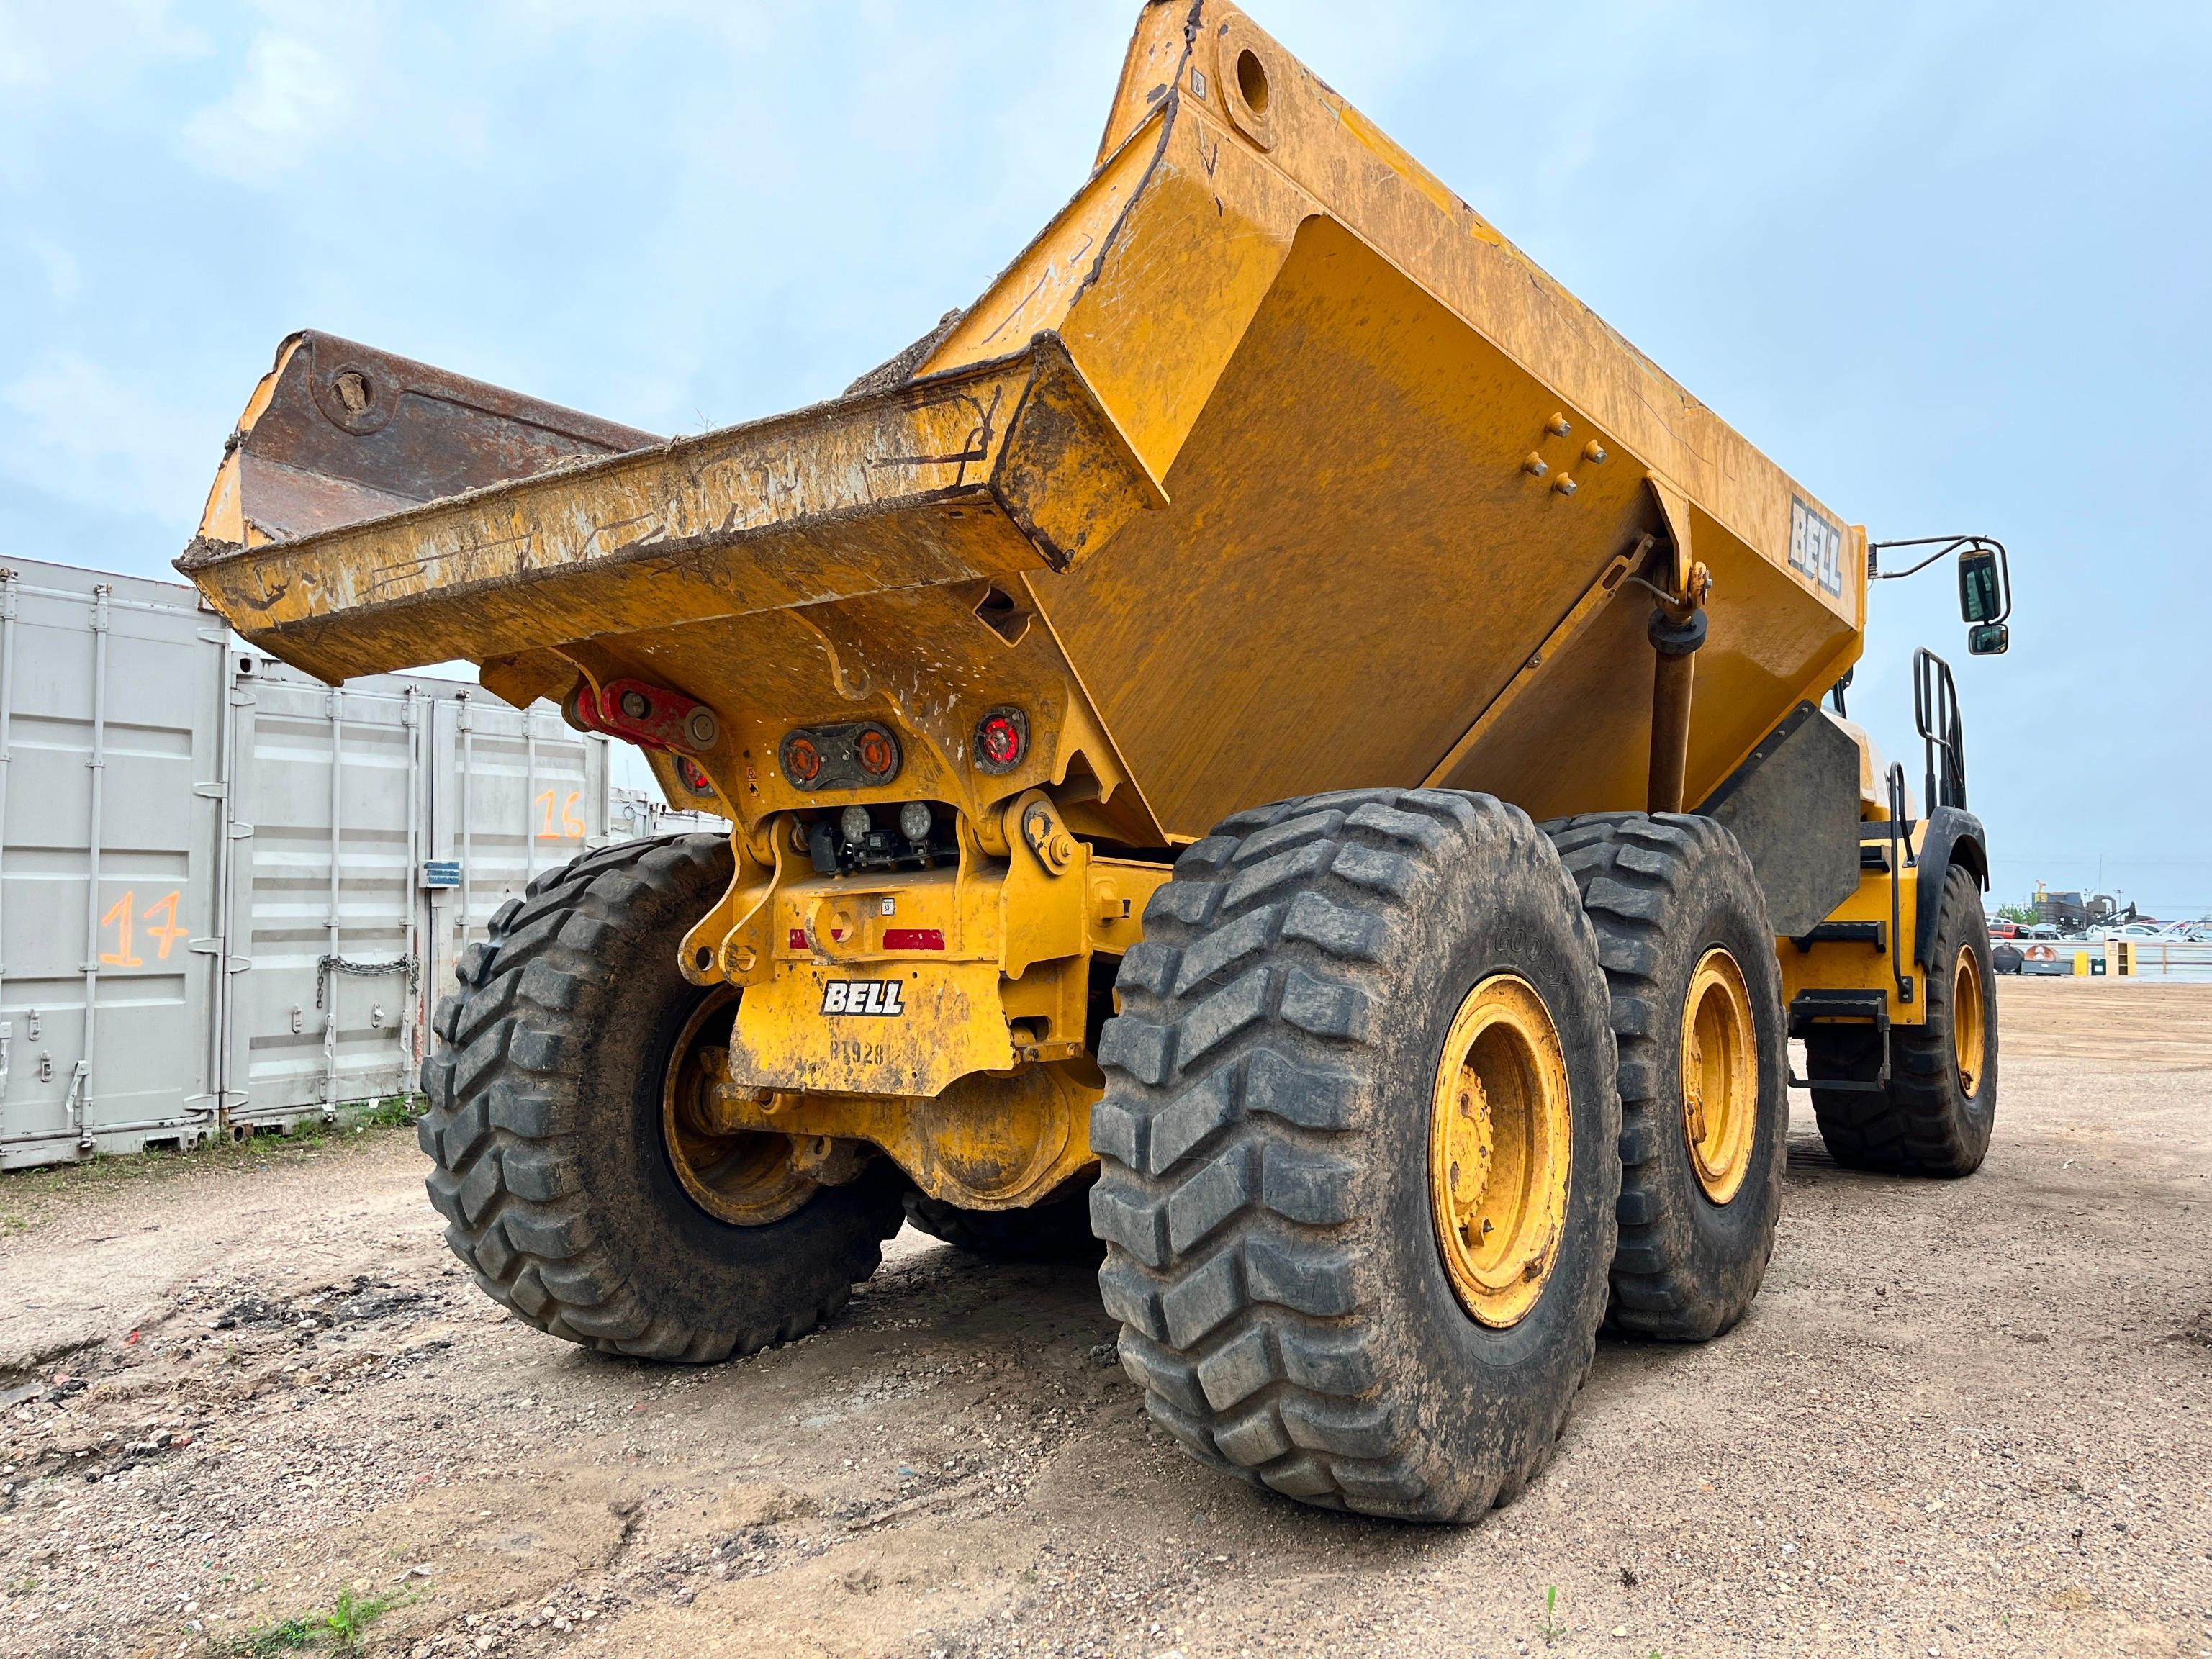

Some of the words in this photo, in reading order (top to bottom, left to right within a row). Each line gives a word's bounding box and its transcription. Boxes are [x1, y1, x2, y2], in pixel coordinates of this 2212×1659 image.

[1789, 495, 1841, 597] BELL
[535, 790, 585, 840] 16
[101, 891, 188, 966] 17
[821, 980, 905, 1016] BELL
